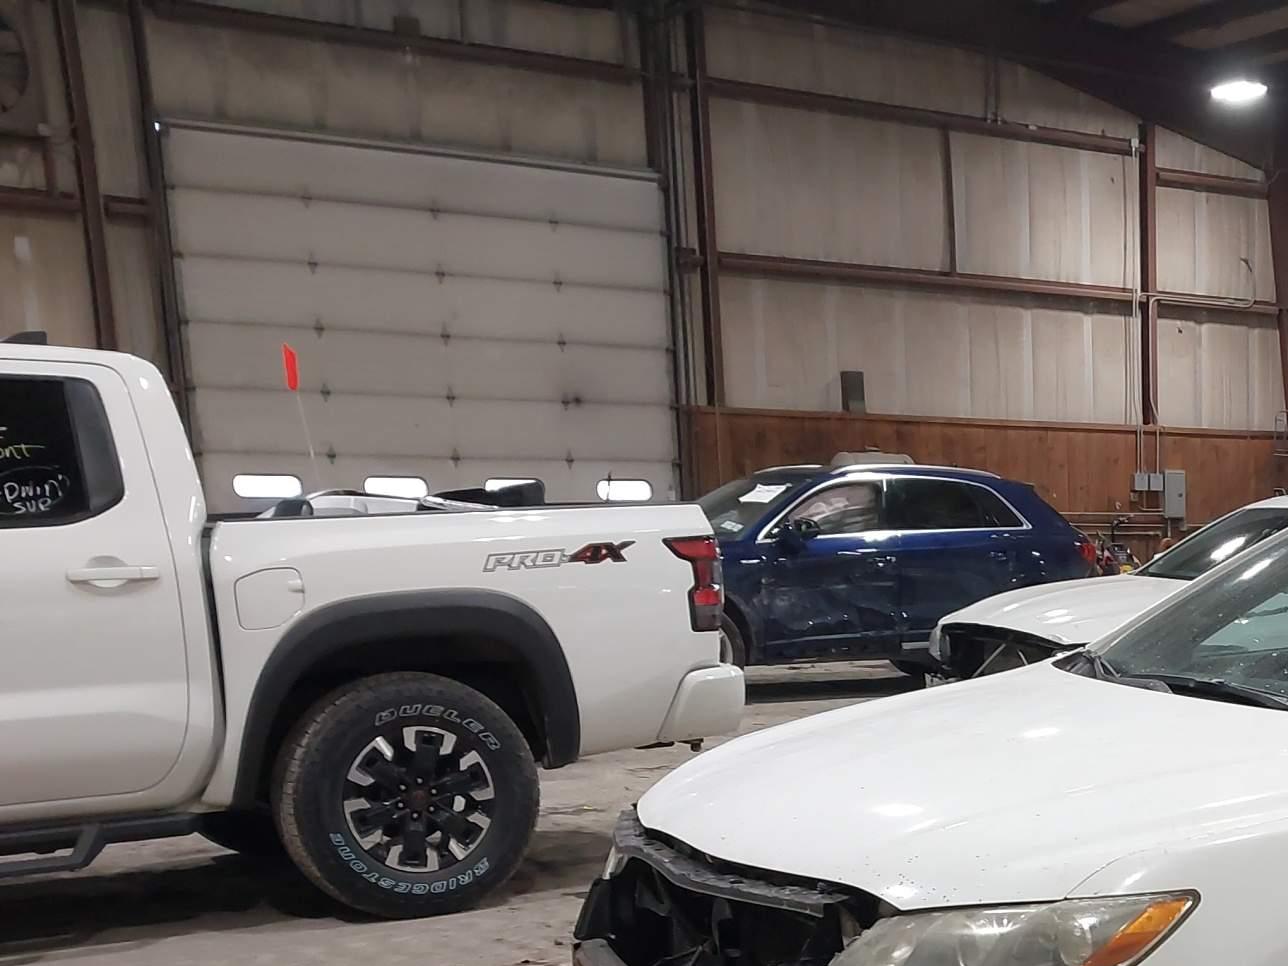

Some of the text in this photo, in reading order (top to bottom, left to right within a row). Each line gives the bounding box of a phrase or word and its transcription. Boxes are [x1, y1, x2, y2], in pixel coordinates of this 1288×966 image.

[482, 541, 636, 573] PRO-4X
[375, 704, 500, 751] DUELER
[329, 832, 490, 894] BRIDGESTONE
